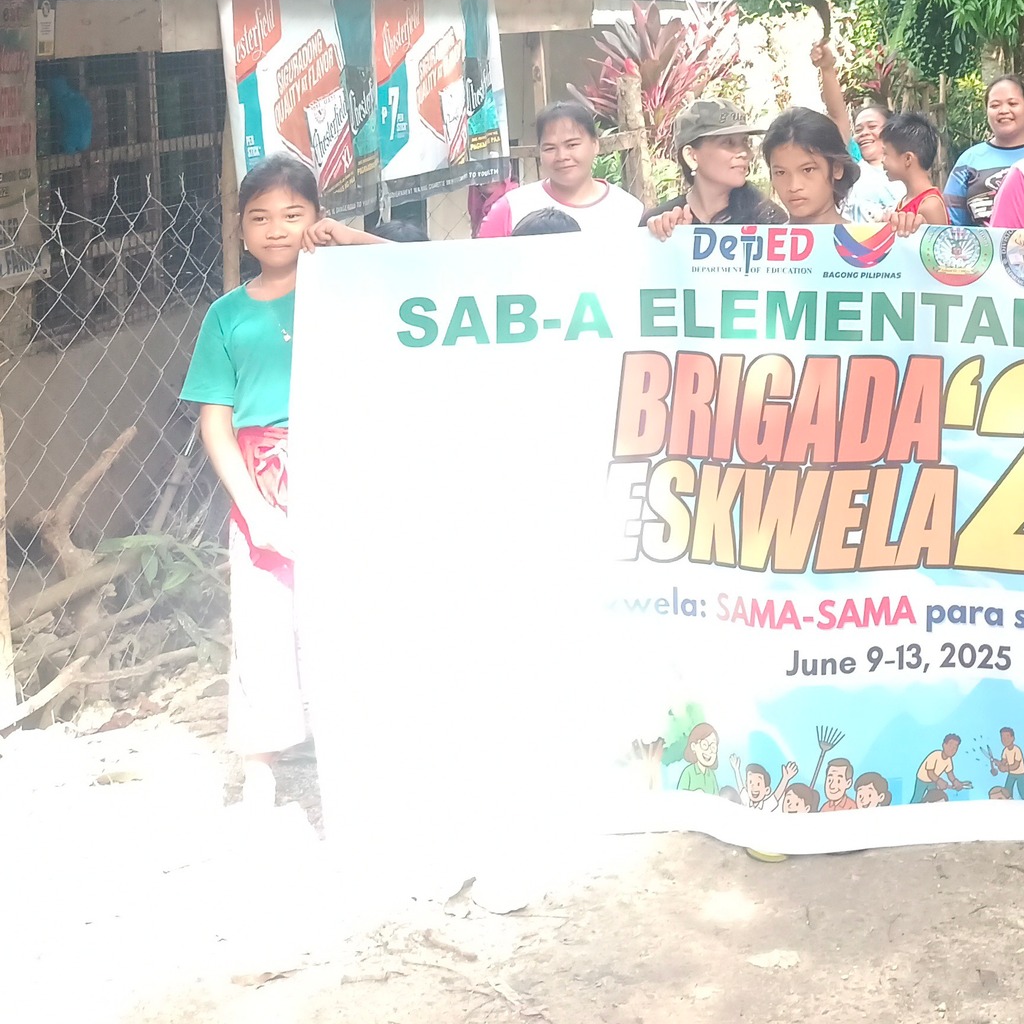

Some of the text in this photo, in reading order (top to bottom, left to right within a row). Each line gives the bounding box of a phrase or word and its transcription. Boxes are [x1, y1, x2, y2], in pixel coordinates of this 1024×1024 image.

[277, 31, 323, 93] SIGURADONG
[691, 265, 813, 275] DEPARTMENT OF EDUCATION
[822, 270, 902, 280] BAGONG PILIPINAS
[396, 292, 613, 348] SAB-A
[612, 350, 944, 466] BRIGADA
[604, 457, 959, 575] ESKWELA
[715, 592, 917, 631] SAMA-SAMA
[926, 602, 1004, 633] para
[785, 642, 1012, 677] June 9-13, 2025
